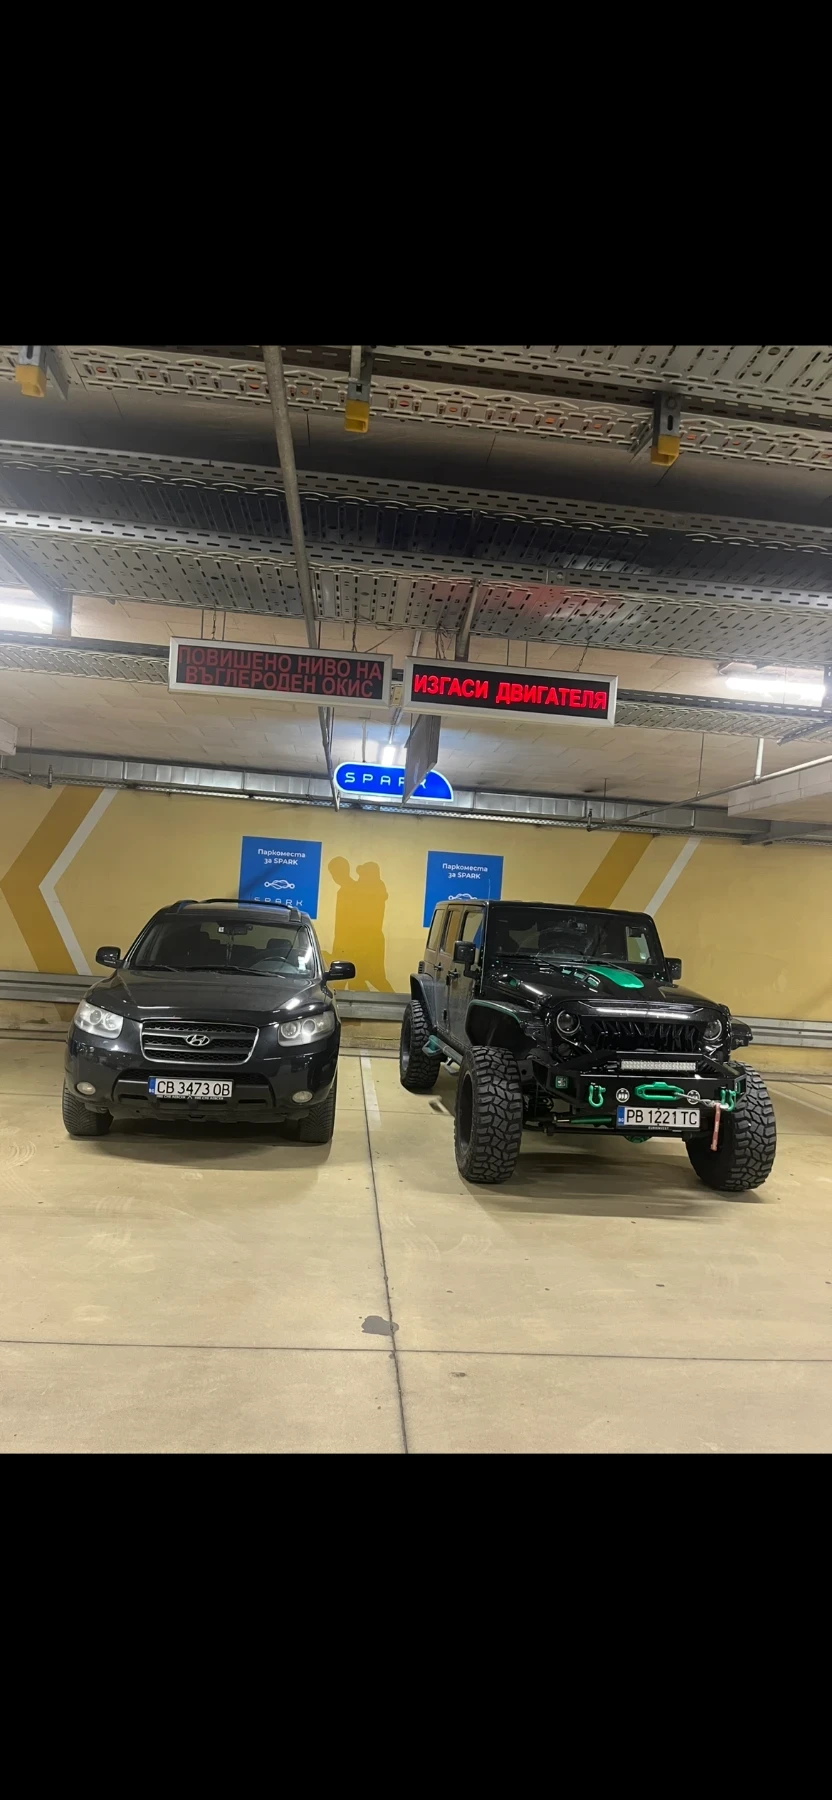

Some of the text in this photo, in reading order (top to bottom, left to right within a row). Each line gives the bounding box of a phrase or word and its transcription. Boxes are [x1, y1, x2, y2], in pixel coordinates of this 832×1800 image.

[178, 646, 382, 681] ПОВИШЕНО НИВО НА
[185, 665, 374, 698] ВЪГЛЕРОДЕН ОКИС
[413, 674, 607, 710] ИЗГАСИ ДВИГАТЕЛЯ
[257, 848, 306, 859] Паркоместа
[273, 857, 299, 866] SPARK
[442, 862, 488, 873] Паркоместа
[457, 871, 481, 880] SPARK
[157, 1080, 175, 1094] CB
[177, 1081, 210, 1096] 3473
[626, 1109, 644, 1123] PB
[647, 1109, 677, 1125] 1221
[680, 1111, 698, 1125] TC
